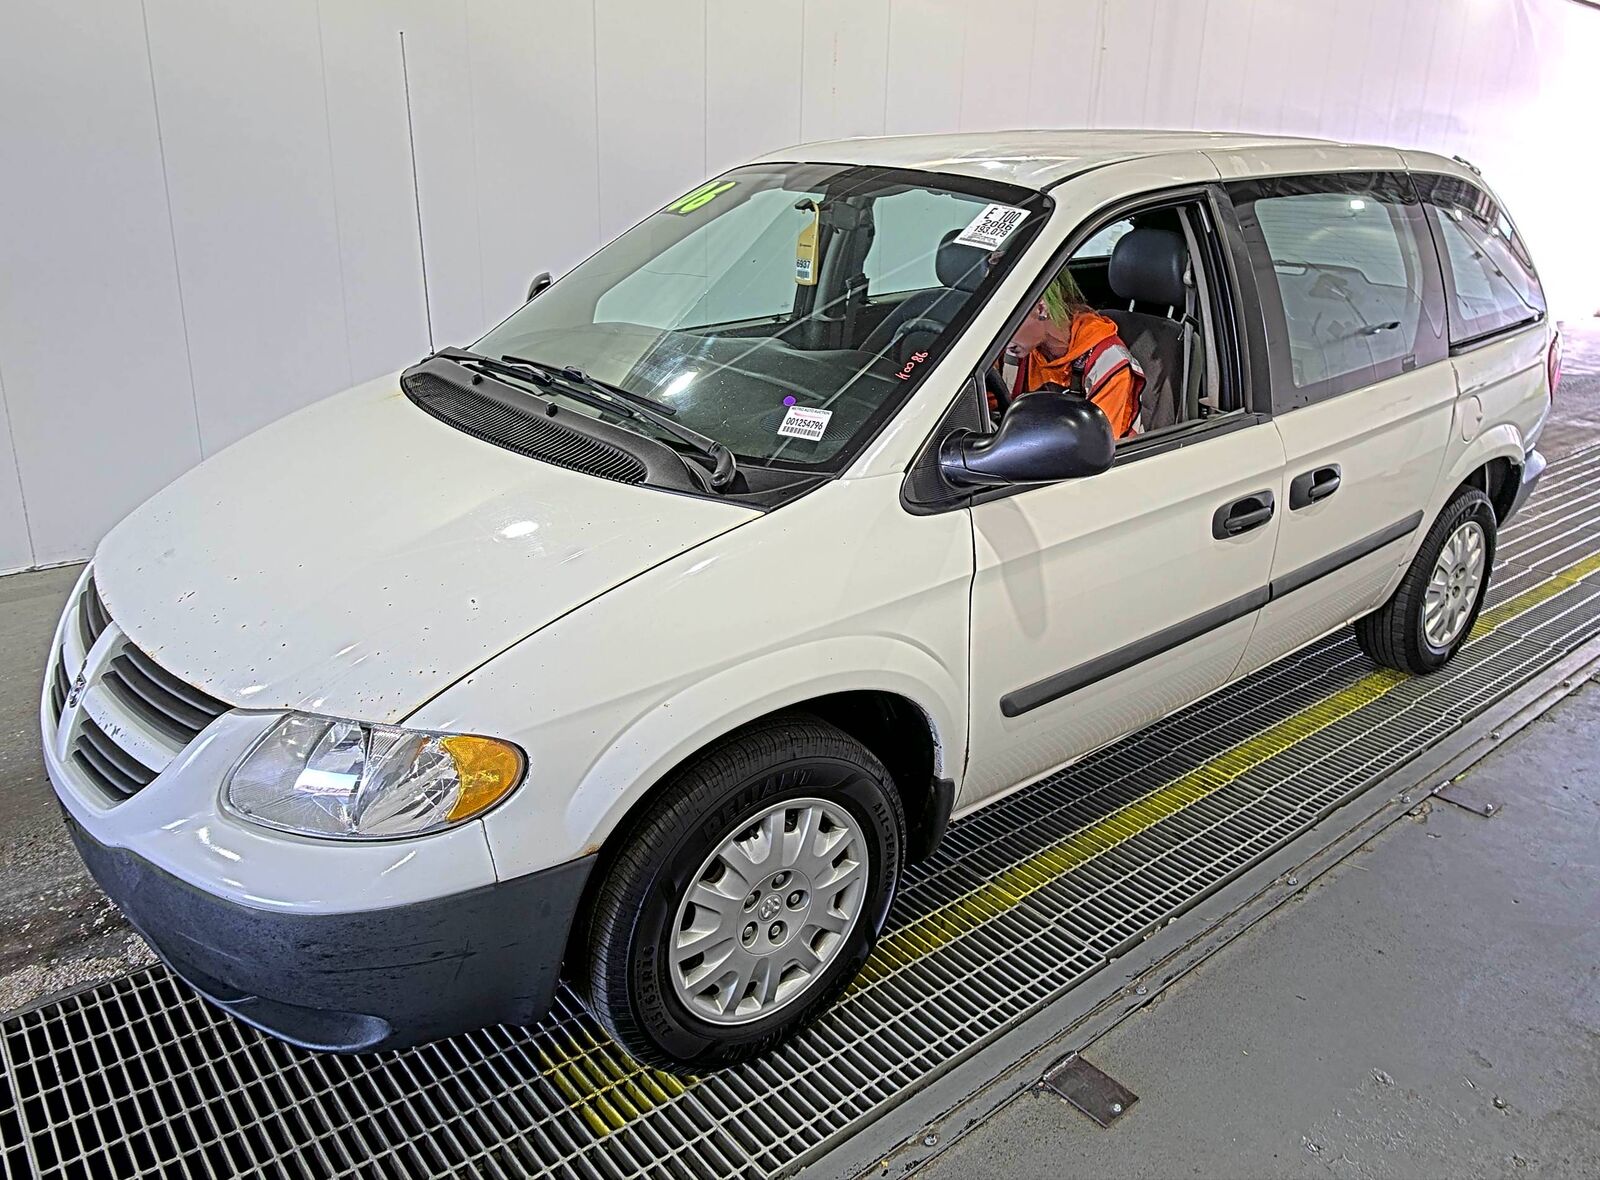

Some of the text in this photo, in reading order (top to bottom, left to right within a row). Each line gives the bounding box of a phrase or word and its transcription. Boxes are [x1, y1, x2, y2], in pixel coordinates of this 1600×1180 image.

[984, 207, 1022, 224] E 100
[981, 219, 1014, 231] 2006
[796, 259, 811, 269] 6937
[786, 417, 824, 431] 001254796
